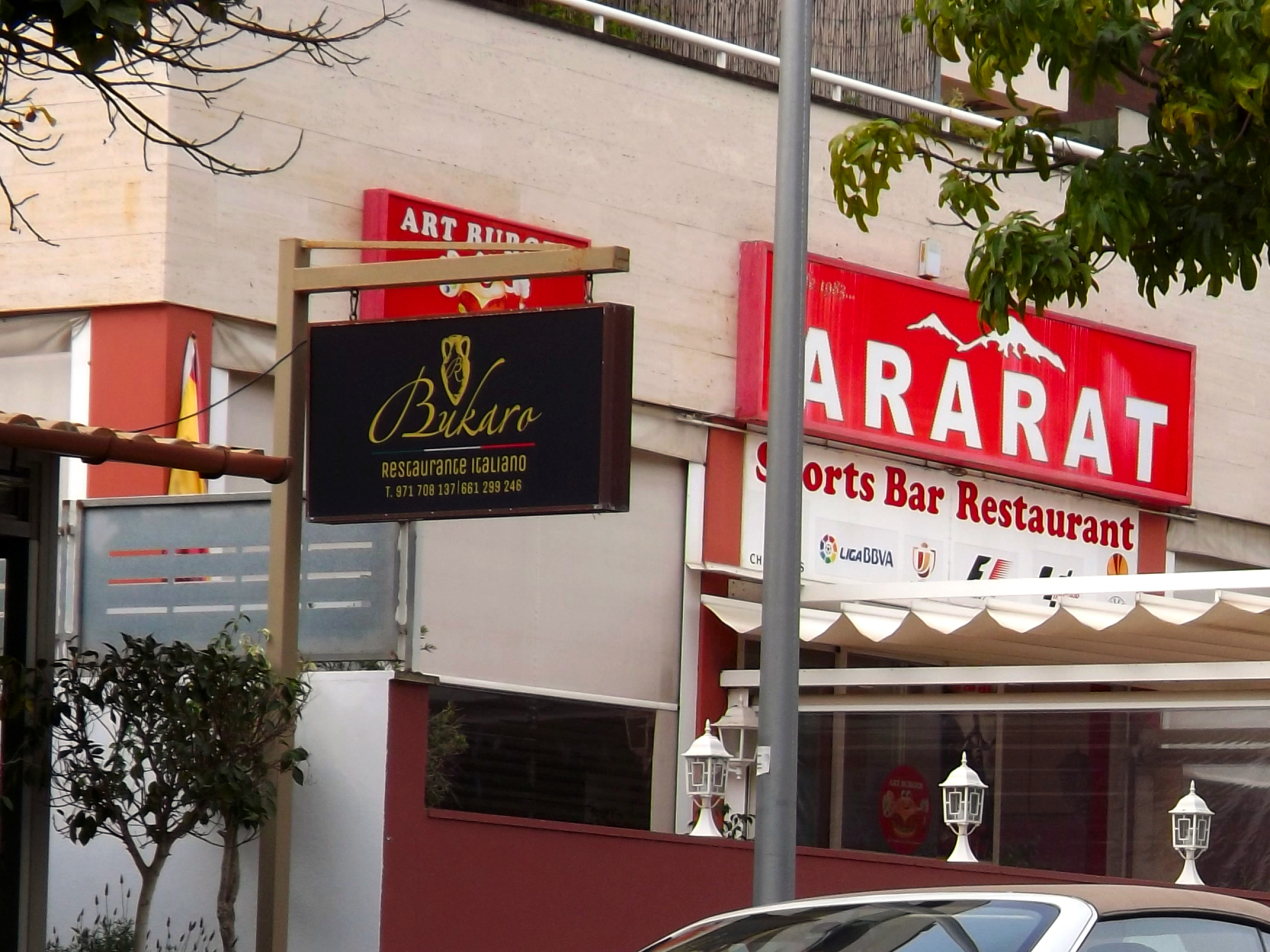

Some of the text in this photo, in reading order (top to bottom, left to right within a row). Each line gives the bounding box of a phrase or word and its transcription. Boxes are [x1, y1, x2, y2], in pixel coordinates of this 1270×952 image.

[400, 206, 457, 241] ART
[368, 357, 543, 444] Bukaro
[804, 326, 1169, 483] ARARAT
[395, 485, 414, 498] 971
[417, 484, 435, 497] 708
[482, 480, 501, 493] 299
[503, 479, 522, 492] 246
[883, 465, 945, 515] Bar
[955, 480, 1135, 551] Restaurant
